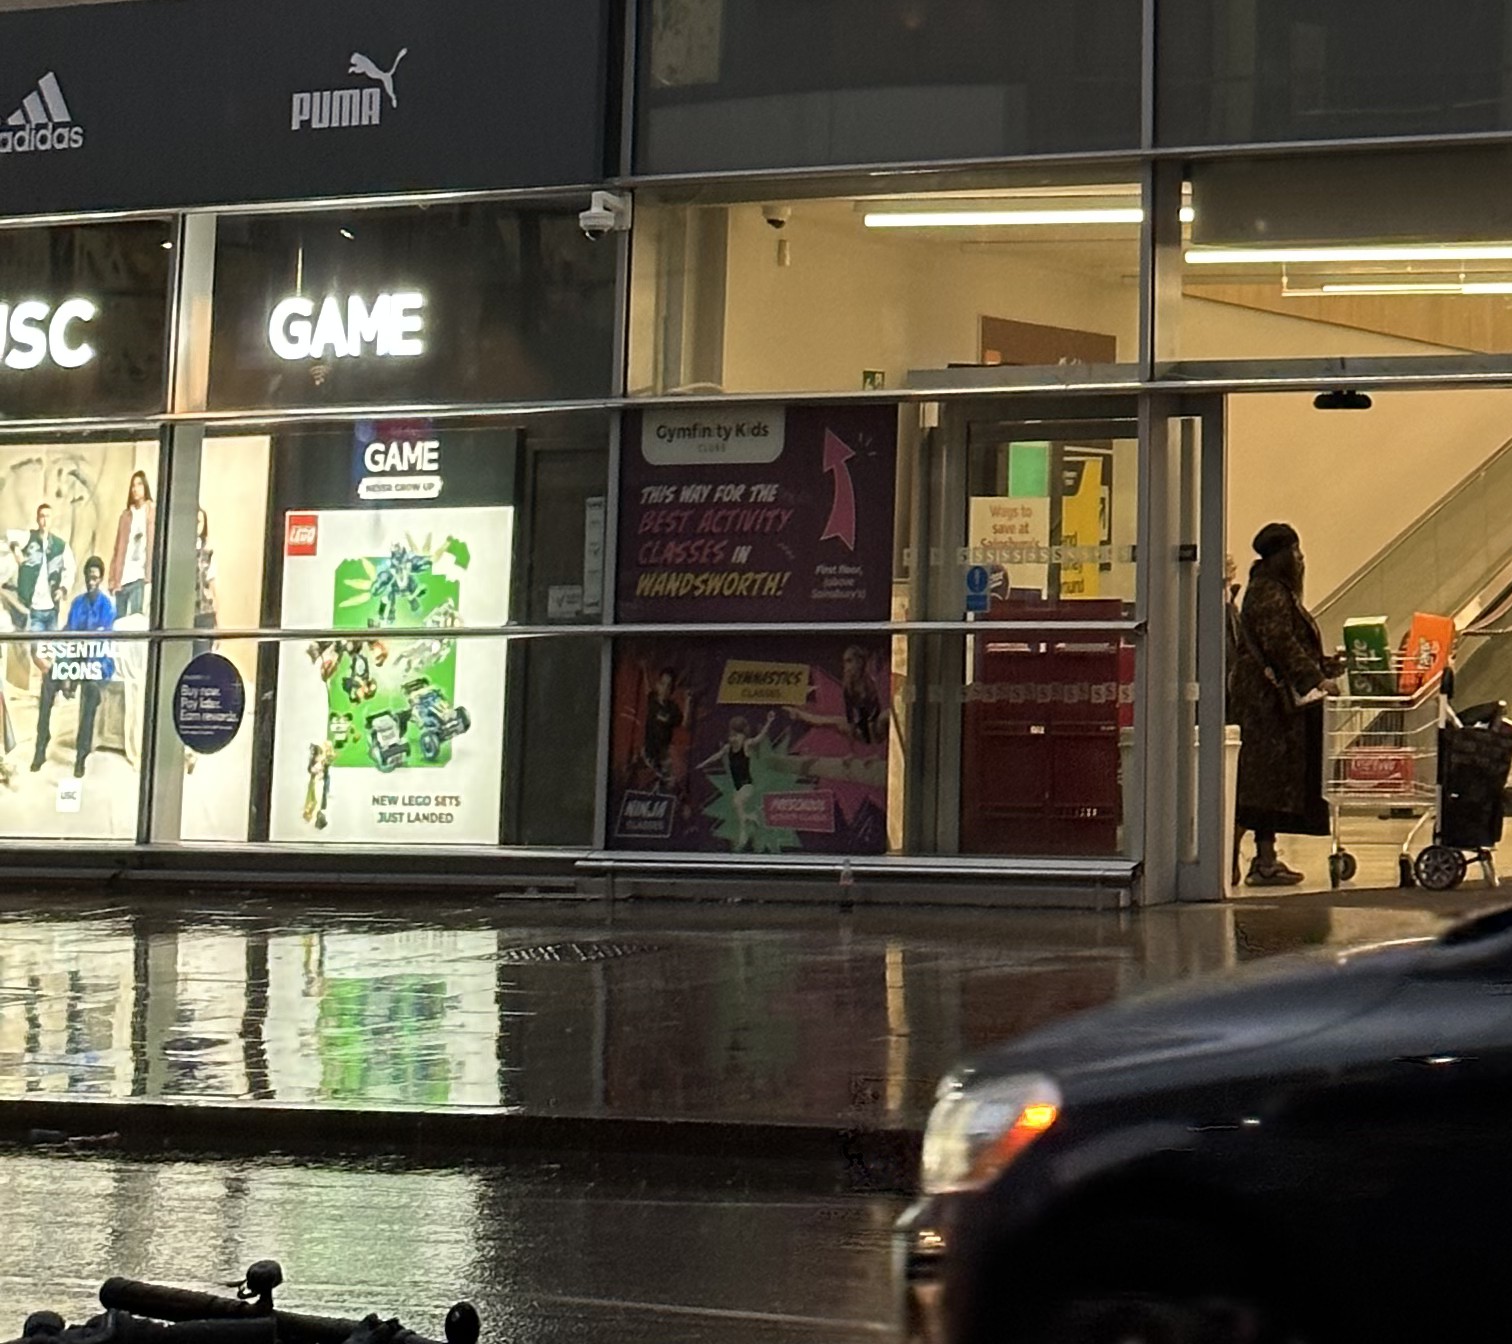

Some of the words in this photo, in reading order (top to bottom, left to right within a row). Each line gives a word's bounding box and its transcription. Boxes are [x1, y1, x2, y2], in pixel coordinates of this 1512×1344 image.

[291, 87, 381, 131] PUMA
[0, 121, 84, 153] adidas
[268, 291, 424, 360] GAME
[656, 422, 733, 444] Gymfinity
[734, 421, 770, 439] Kids
[364, 439, 440, 473] GAME
[395, 483, 420, 492] GROW
[422, 482, 435, 491] UP
[640, 484, 677, 505] THIS
[679, 483, 708, 503] WAY
[713, 483, 746, 503] FOR
[748, 482, 779, 503] THE
[638, 509, 695, 535] BEST
[696, 508, 794, 533] ACTIVITY
[989, 505, 1018, 518] Ways
[1021, 505, 1033, 518] to
[992, 523, 1016, 534] save
[1018, 522, 1029, 534] at
[637, 539, 729, 566] CLASSES
[730, 545, 752, 564] IN
[636, 571, 791, 597] WANDSWORTH!
[51, 661, 103, 680] ICONS
[181, 684, 198, 698] Buy
[181, 696, 199, 711] Pay
[372, 795, 399, 806] NEW
[401, 795, 432, 807] LEGO
[434, 795, 461, 807] SETS
[377, 812, 405, 823] JUST
[407, 812, 454, 824] LANDED
